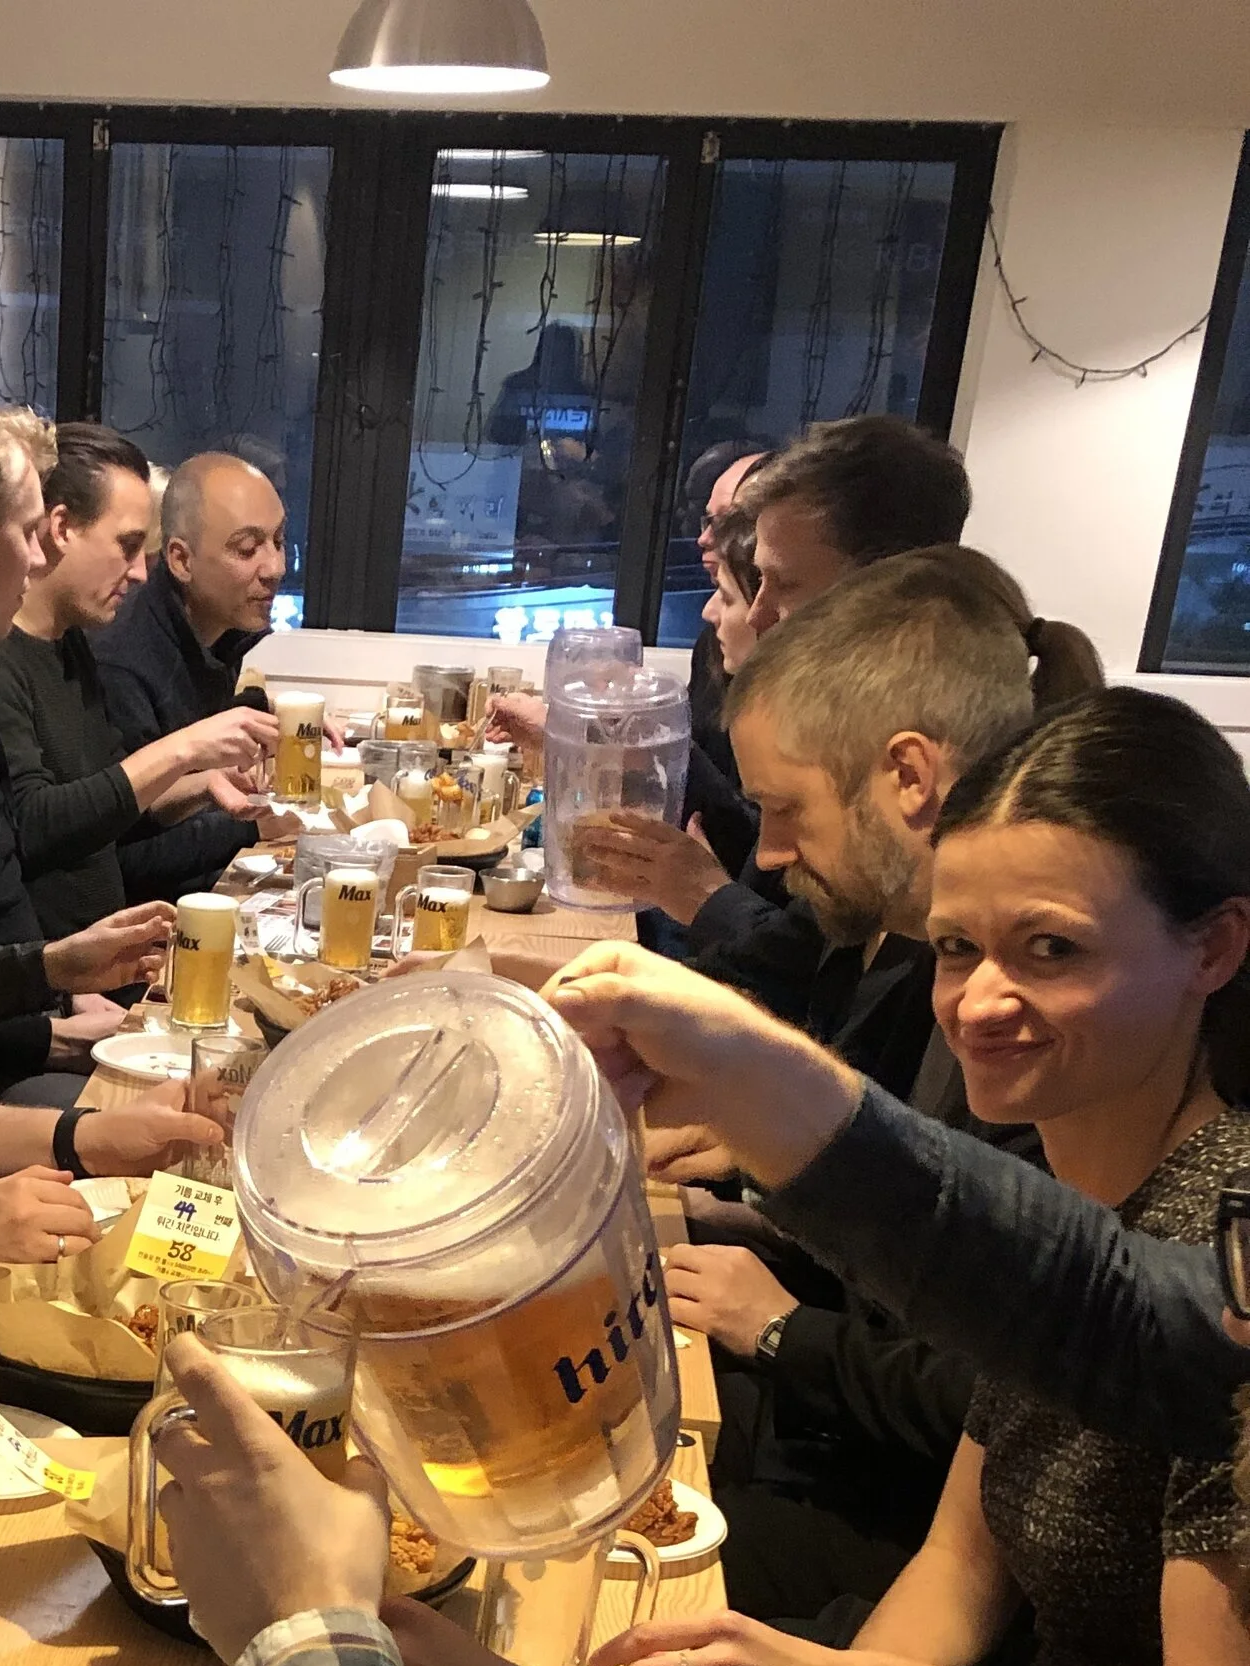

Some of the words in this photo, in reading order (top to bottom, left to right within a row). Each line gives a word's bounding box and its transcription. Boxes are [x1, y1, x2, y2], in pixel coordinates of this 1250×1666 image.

[338, 885, 372, 902] Max
[417, 893, 448, 913] Max
[175, 1184, 192, 1199] 기름
[214, 1195, 223, 1206] 후
[167, 1240, 196, 1262] 58
